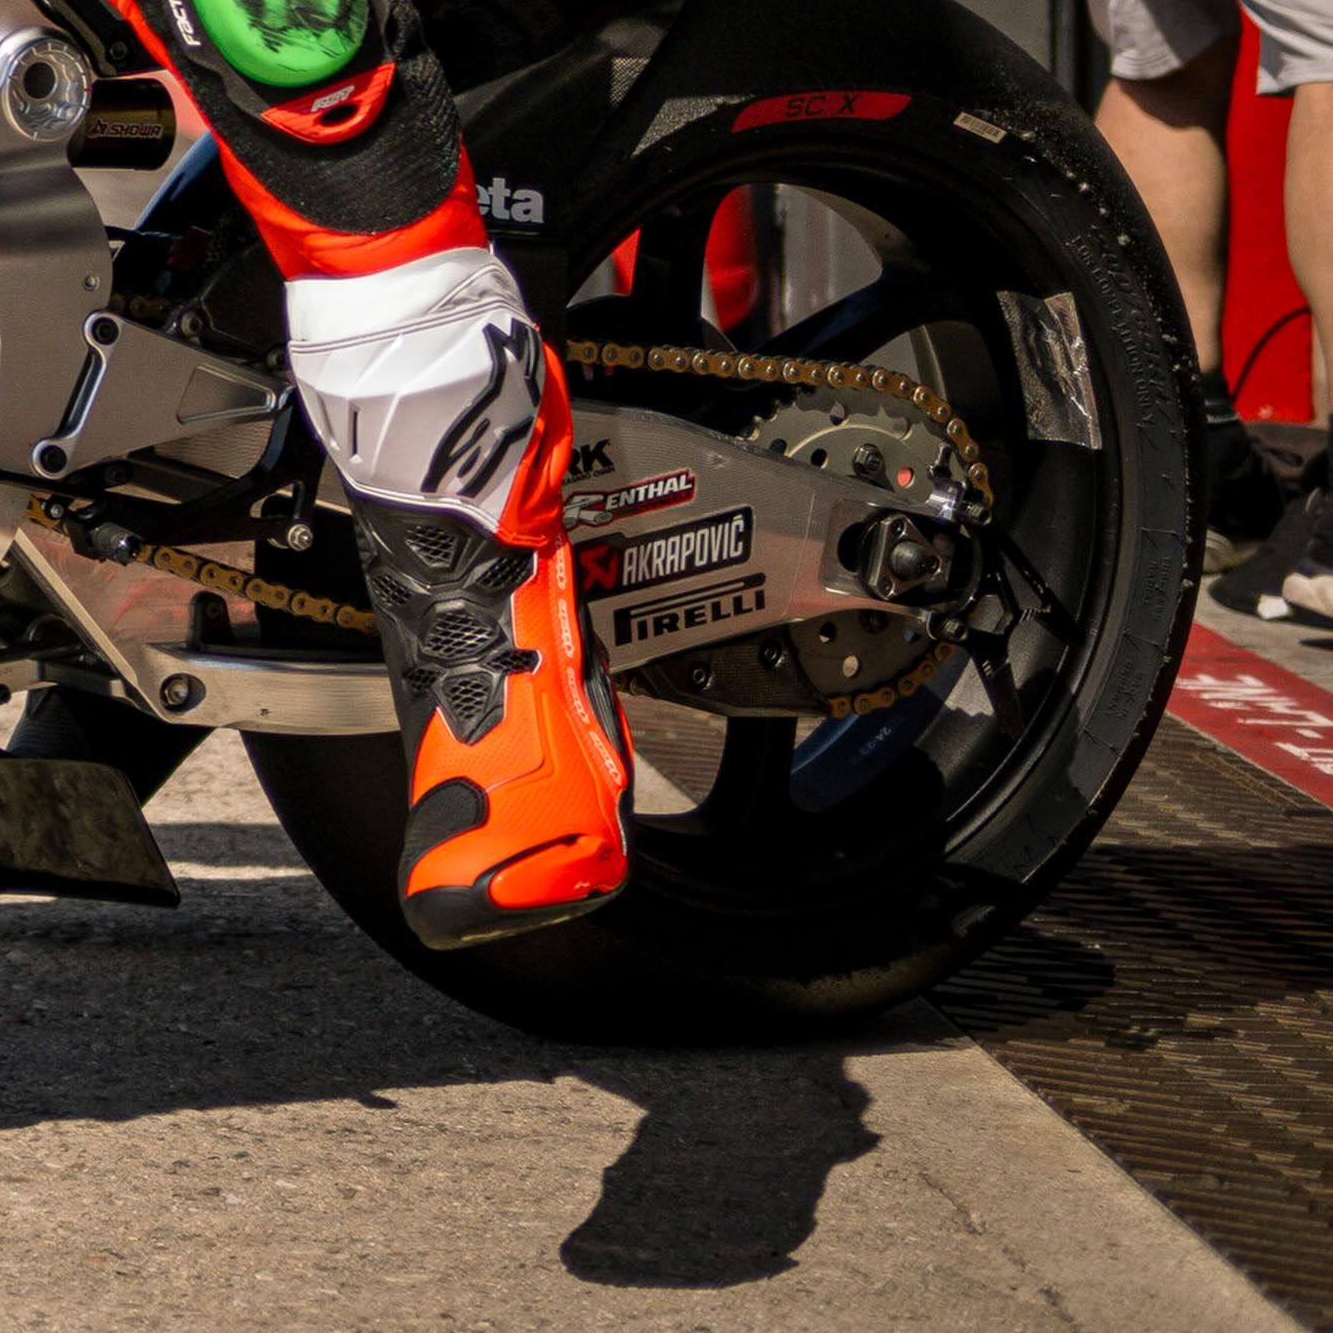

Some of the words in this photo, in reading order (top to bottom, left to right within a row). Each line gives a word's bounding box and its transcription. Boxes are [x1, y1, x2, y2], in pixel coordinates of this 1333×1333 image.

[786, 95, 825, 118] SC
[837, 92, 860, 115] X
[613, 571, 767, 647] PIRELLI
